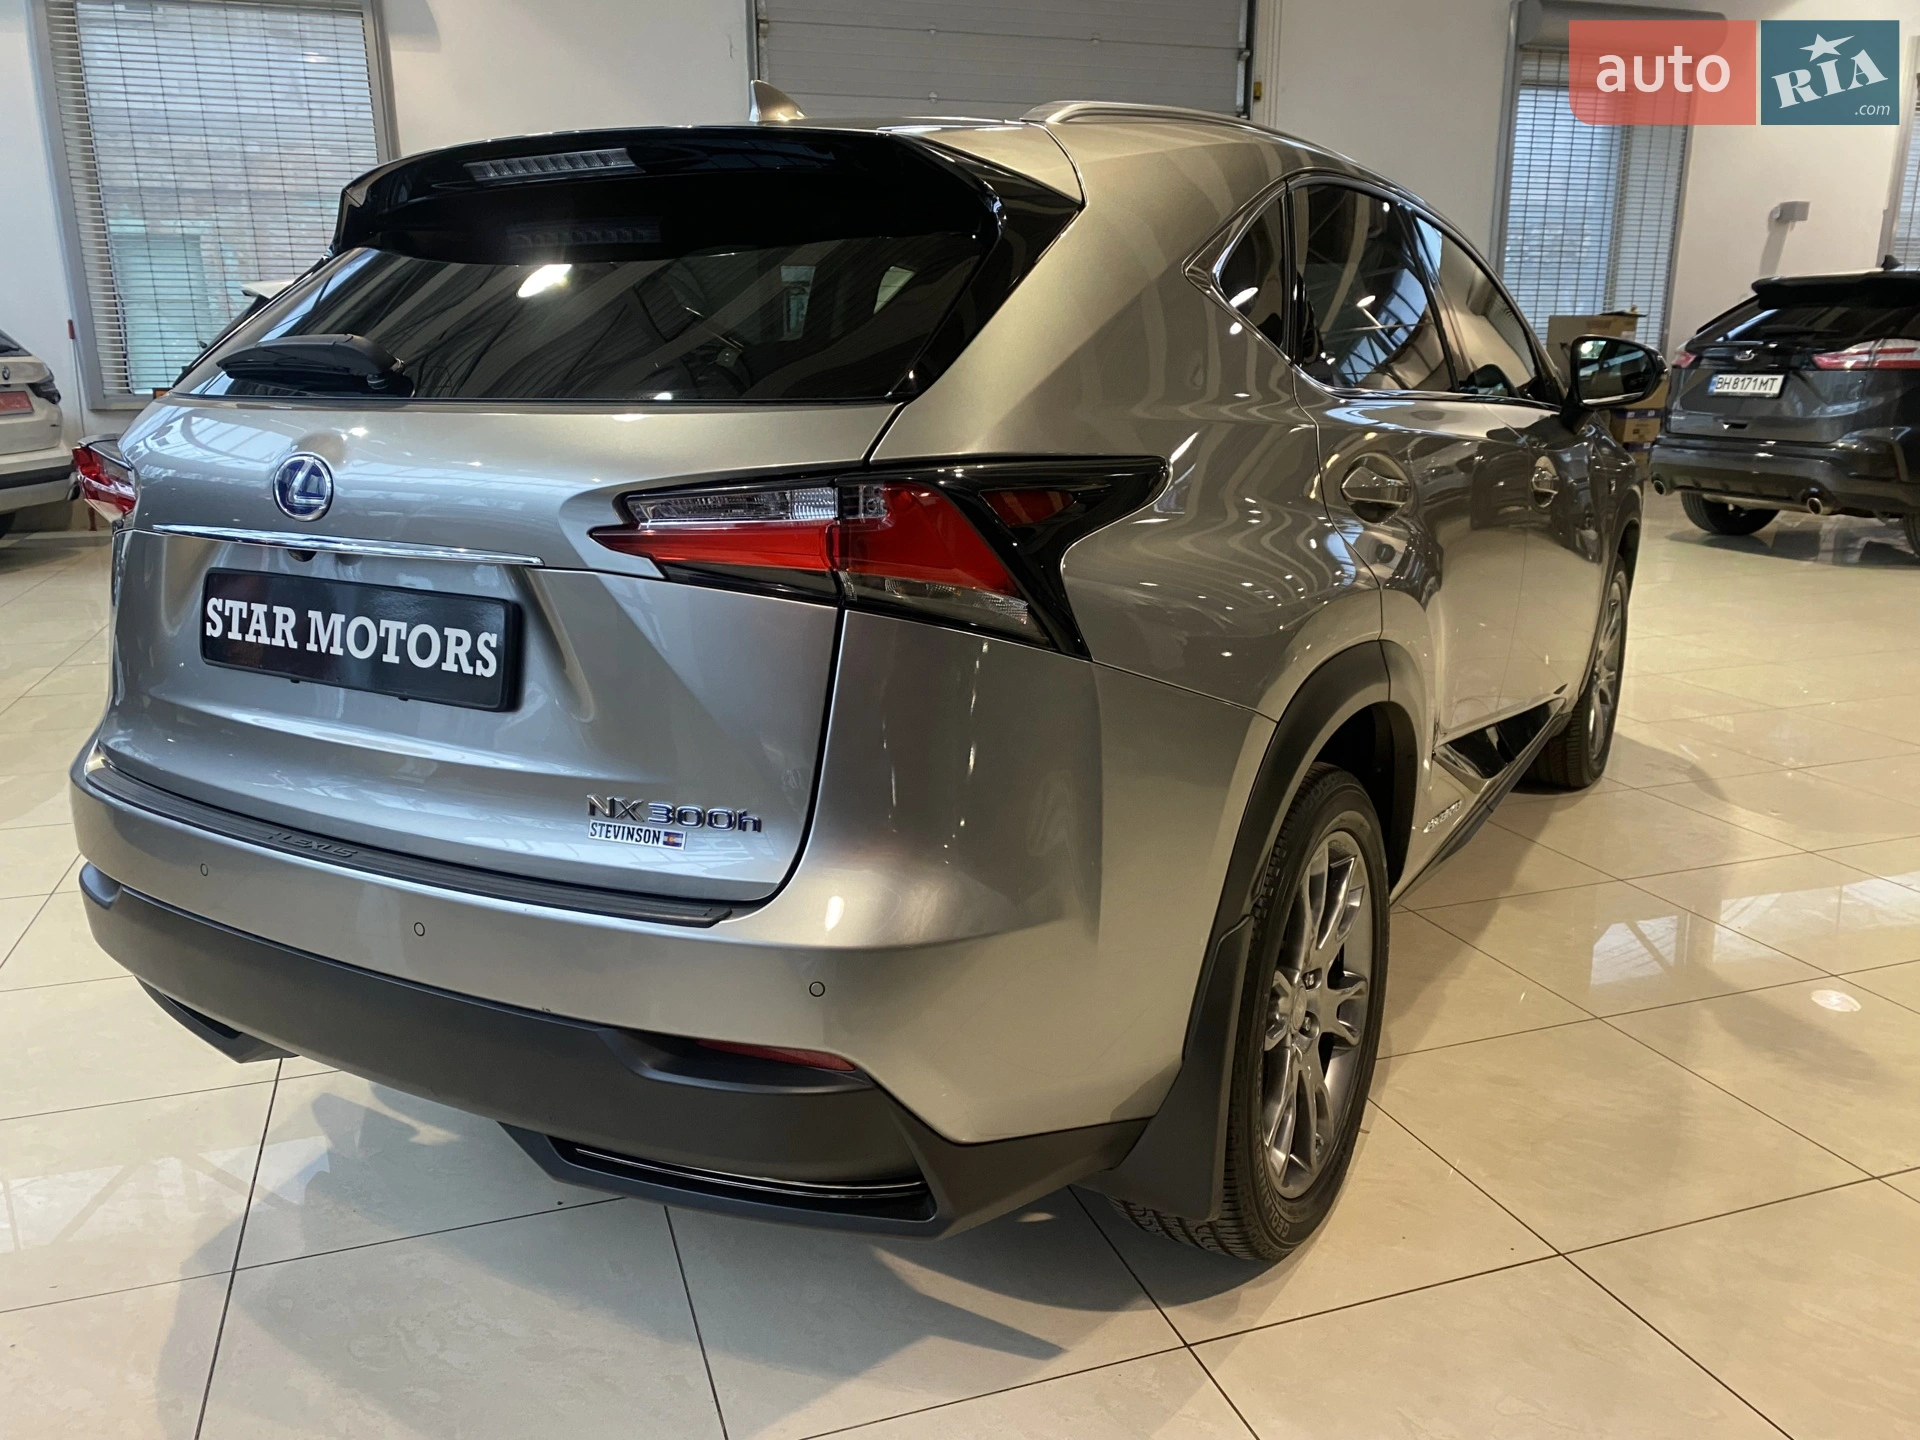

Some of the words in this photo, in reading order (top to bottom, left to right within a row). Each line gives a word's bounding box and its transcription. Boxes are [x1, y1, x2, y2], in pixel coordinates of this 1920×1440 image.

[205, 597, 298, 649] STAR
[305, 609, 498, 678] MOTORS
[589, 821, 662, 845] STEVINSON
